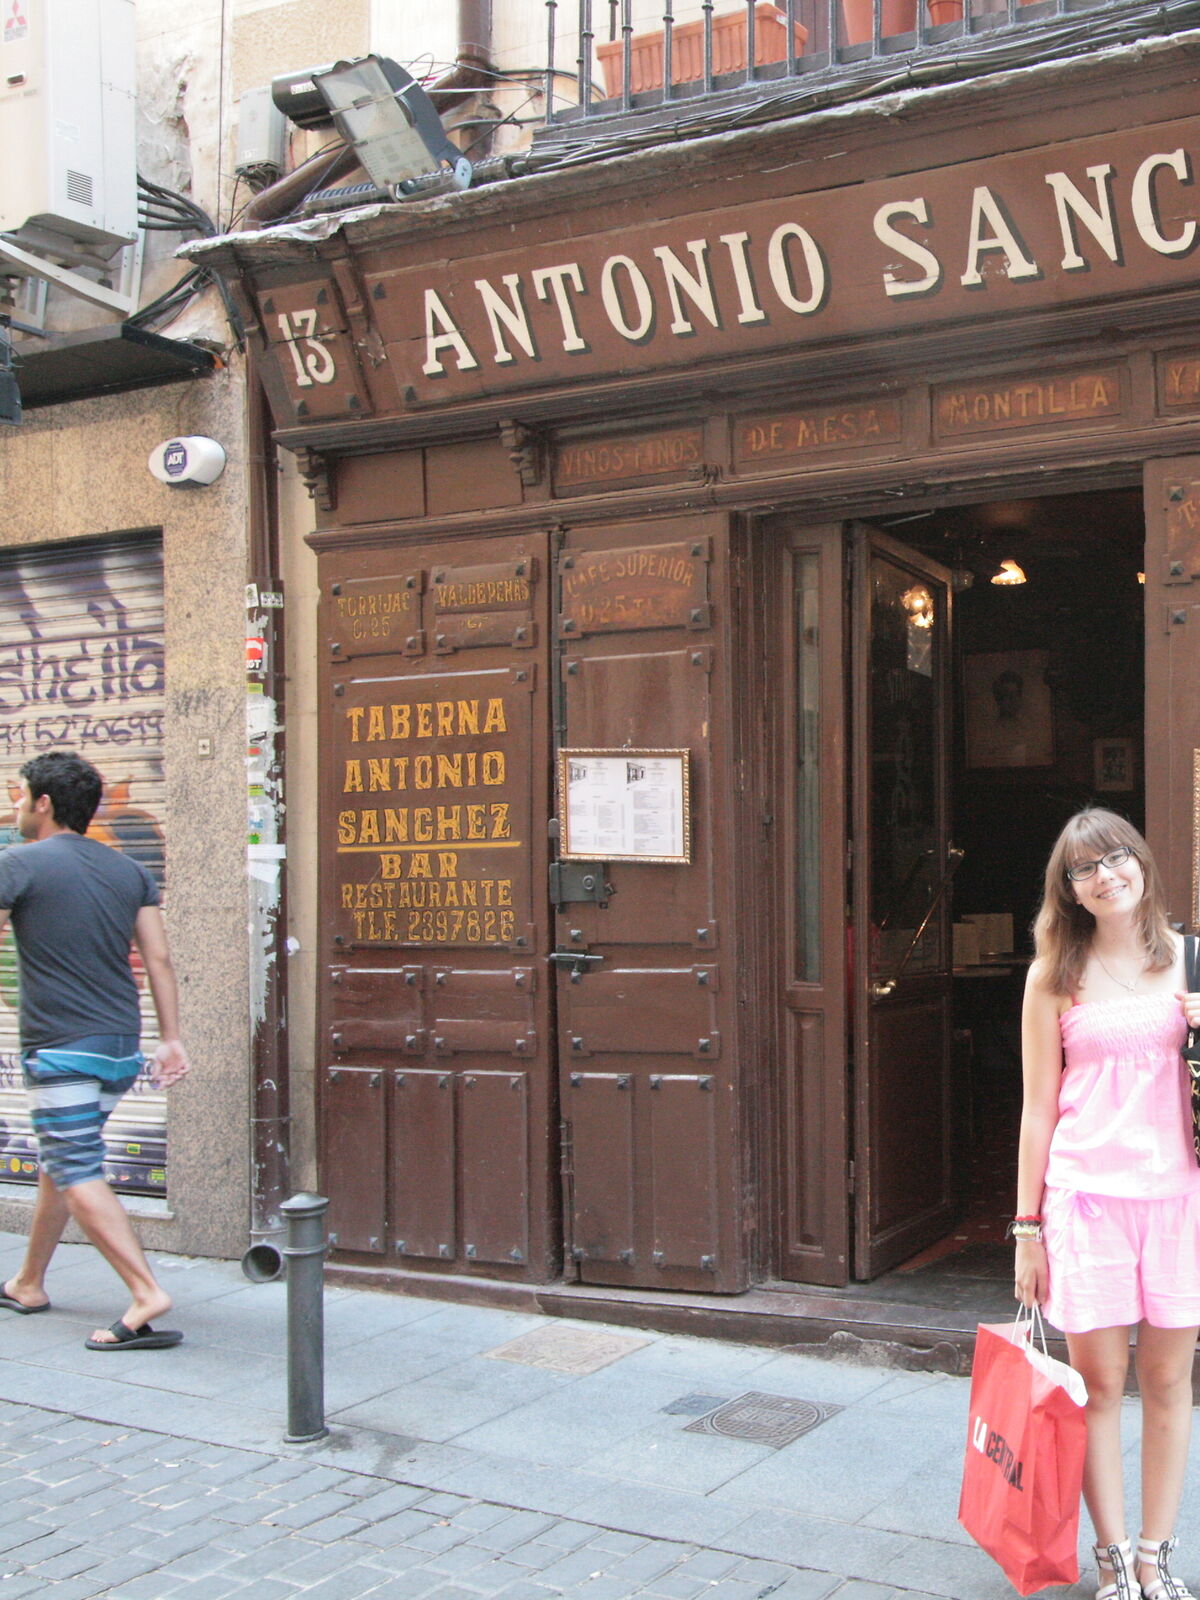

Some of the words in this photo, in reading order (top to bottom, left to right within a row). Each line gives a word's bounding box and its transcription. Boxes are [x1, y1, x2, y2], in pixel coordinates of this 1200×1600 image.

[422, 222, 825, 375] ANTONIO
[278, 309, 335, 386] 13
[948, 380, 1108, 425] MONTILLA
[750, 421, 783, 452] DE
[797, 409, 881, 448] MESA
[167, 451, 184, 466] ADT
[616, 553, 695, 587] SUPERIOR
[346, 698, 508, 742] TABERNA
[343, 751, 506, 792] ANTONIO
[337, 803, 511, 845] SANCHEZ
[379, 852, 459, 879] BAR
[341, 879, 513, 909] RESTAURANTE
